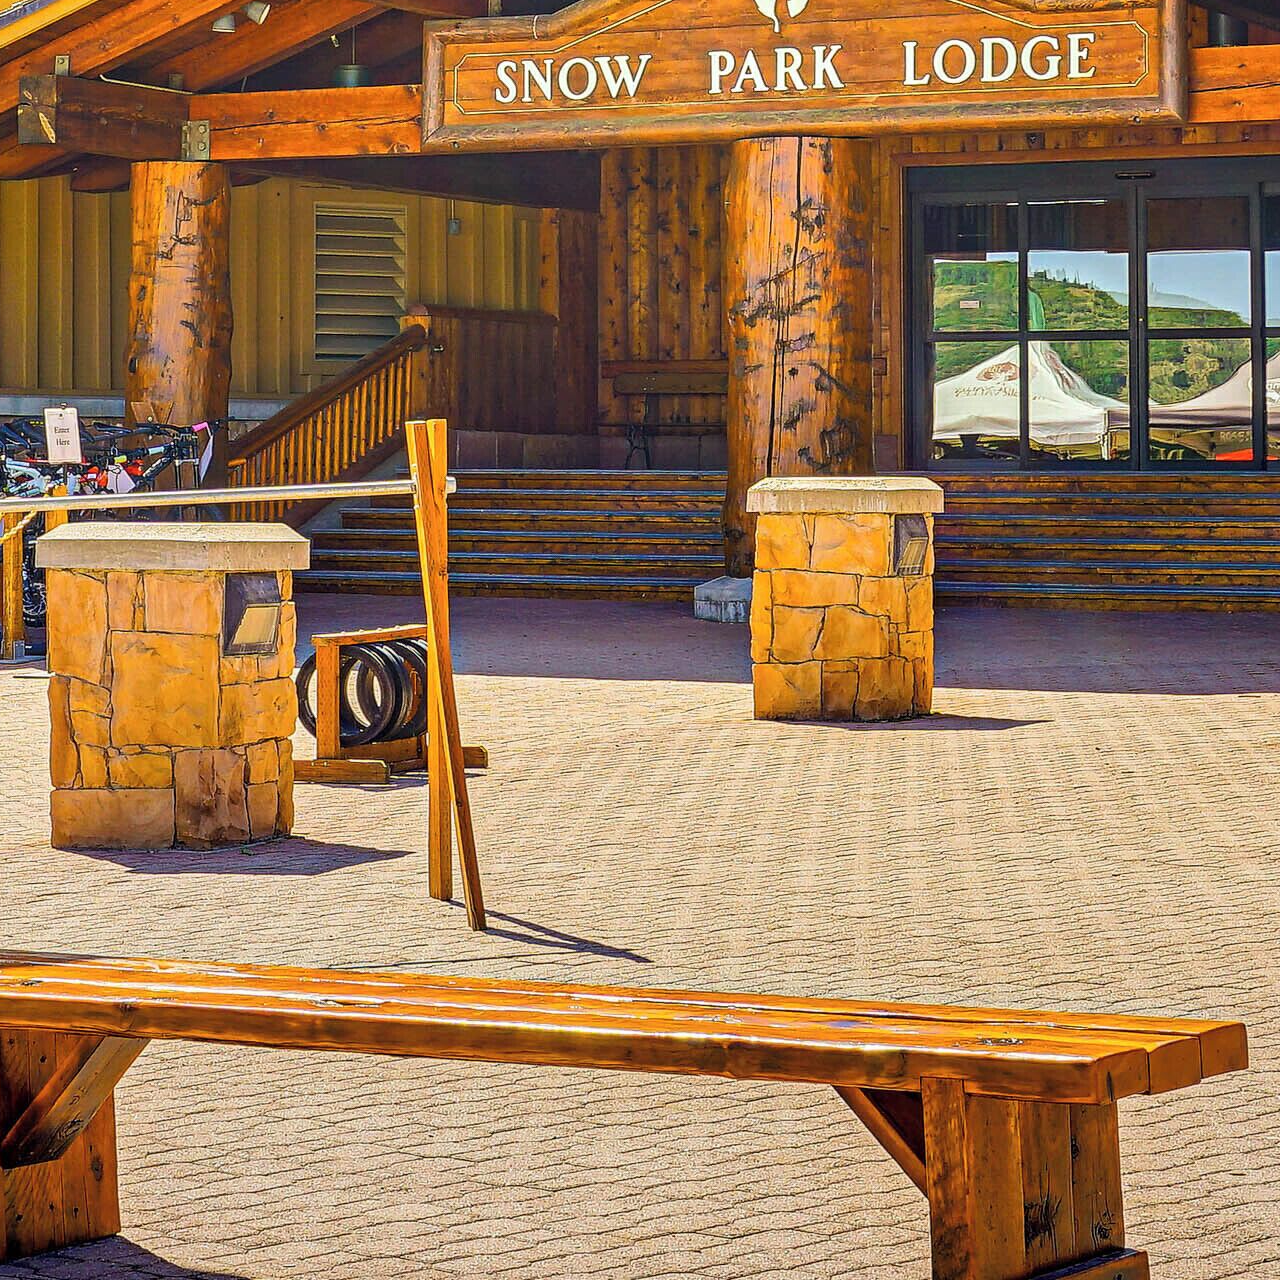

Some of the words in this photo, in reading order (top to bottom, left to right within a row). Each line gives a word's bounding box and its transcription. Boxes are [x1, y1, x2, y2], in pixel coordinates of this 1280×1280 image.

[494, 53, 651, 105] SNOW
[708, 44, 845, 96] PARK
[903, 33, 1097, 87] LODGE
